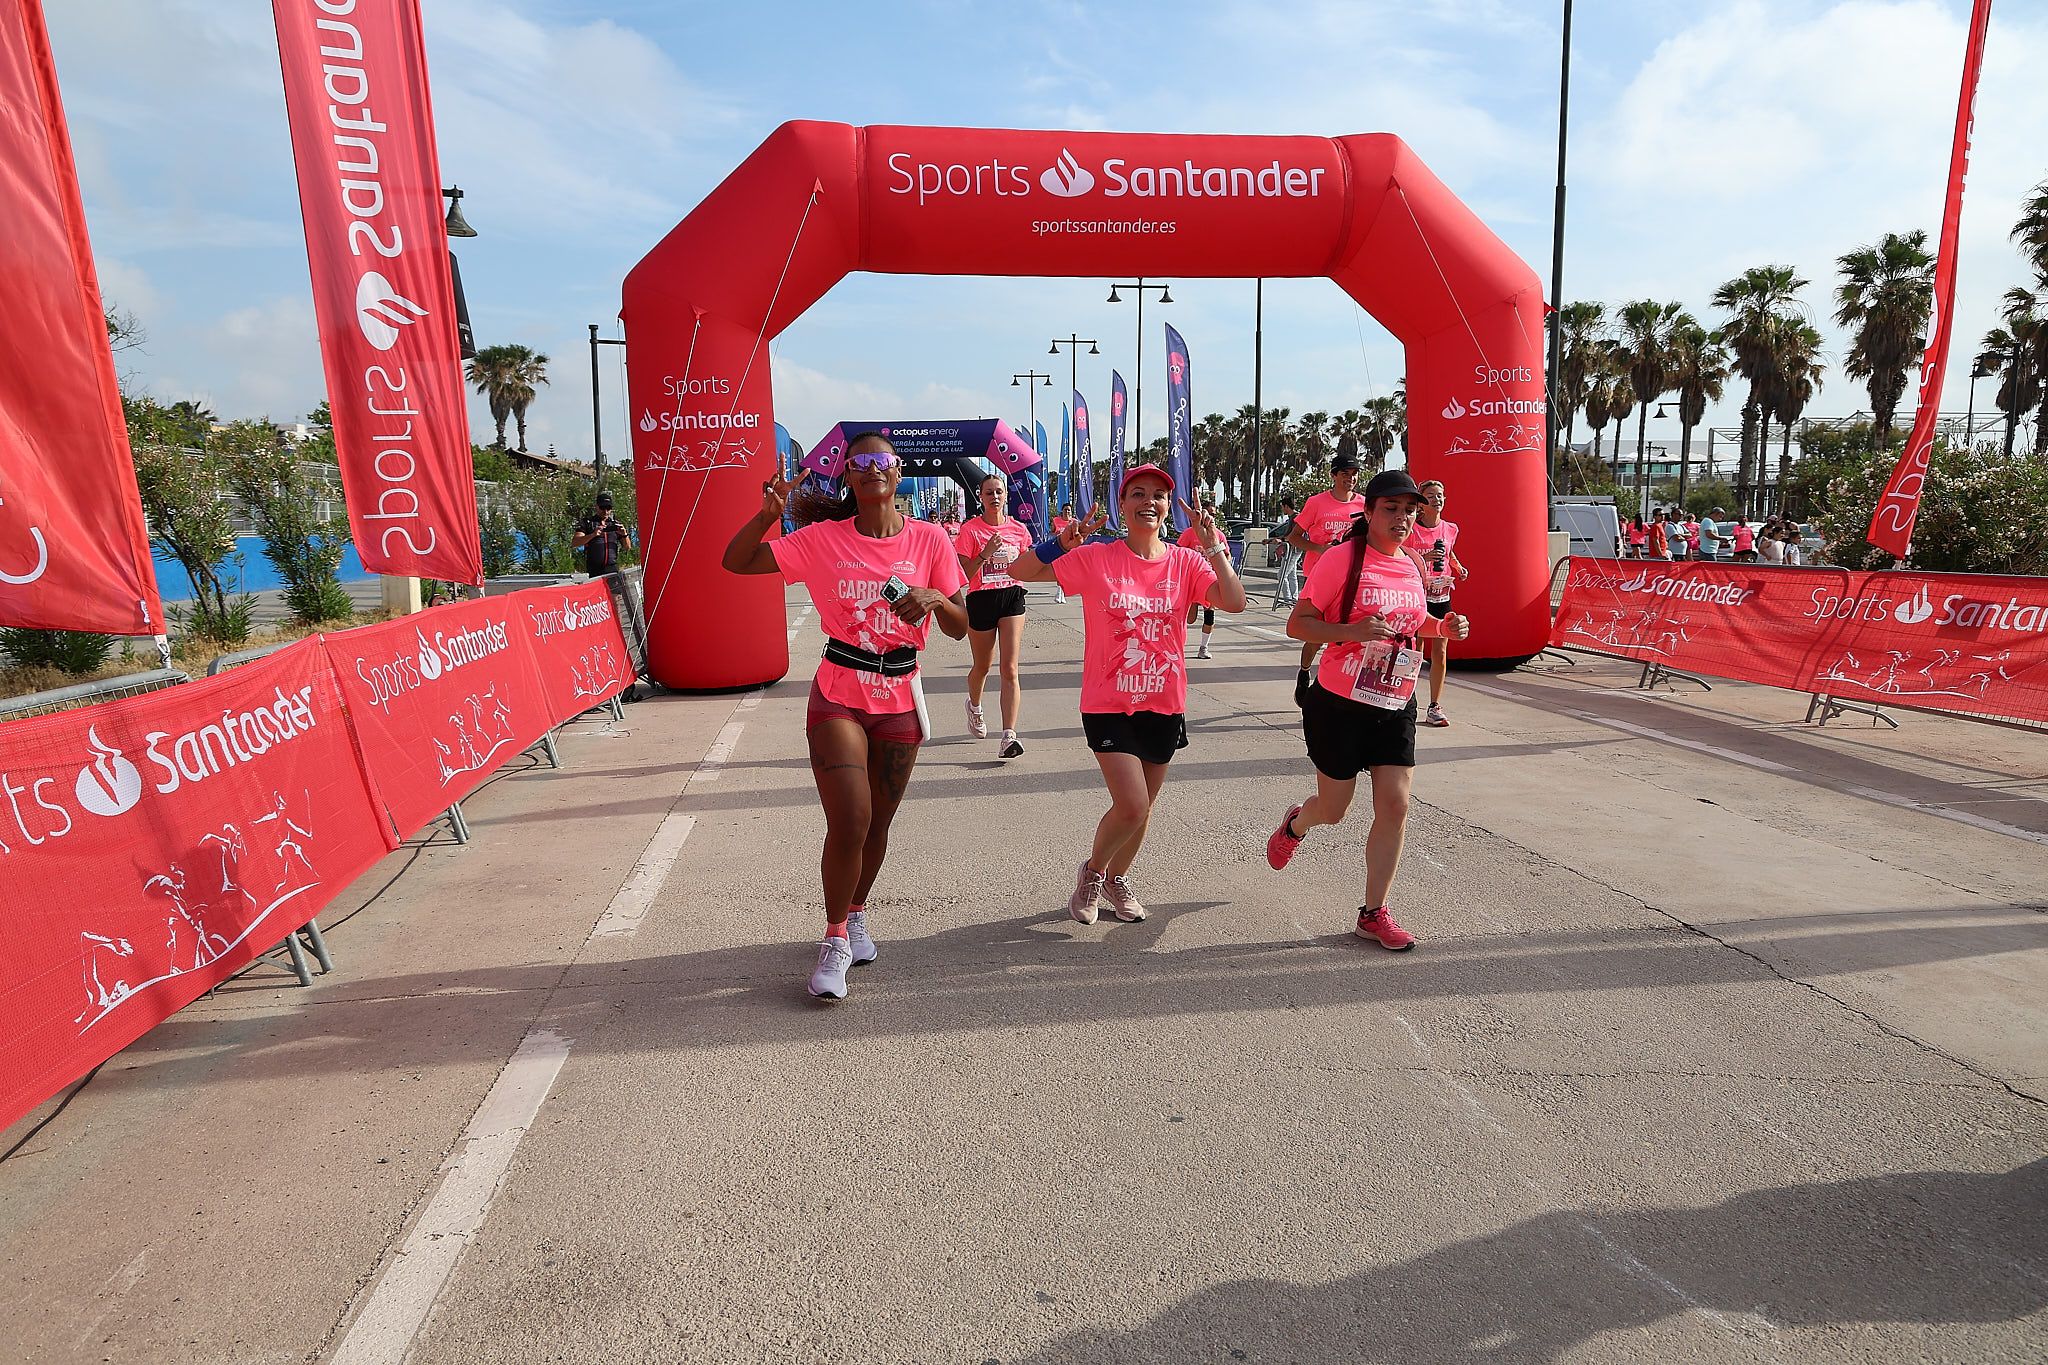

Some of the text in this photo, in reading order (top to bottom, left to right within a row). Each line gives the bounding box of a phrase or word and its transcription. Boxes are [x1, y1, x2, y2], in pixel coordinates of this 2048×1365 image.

[888, 153, 1326, 206] Sports Santander
[1031, 218, 1176, 236] sportssantander.es
[1475, 365, 1532, 387] Sports
[663, 375, 730, 400] Sports
[1469, 397, 1548, 417] Santander
[660, 409, 760, 431] Santander
[893, 428, 959, 438] octopus energy
[1362, 588, 1421, 608] CARRERA
[1568, 568, 1754, 606] Sports Santander
[1109, 592, 1173, 614] CARRERA
[1803, 587, 1892, 625] Sports
[527, 596, 612, 644] Sports Santander
[356, 618, 509, 715] Sports Santander
[1116, 674, 1166, 694] MUJER
[145, 686, 317, 794] Santander
